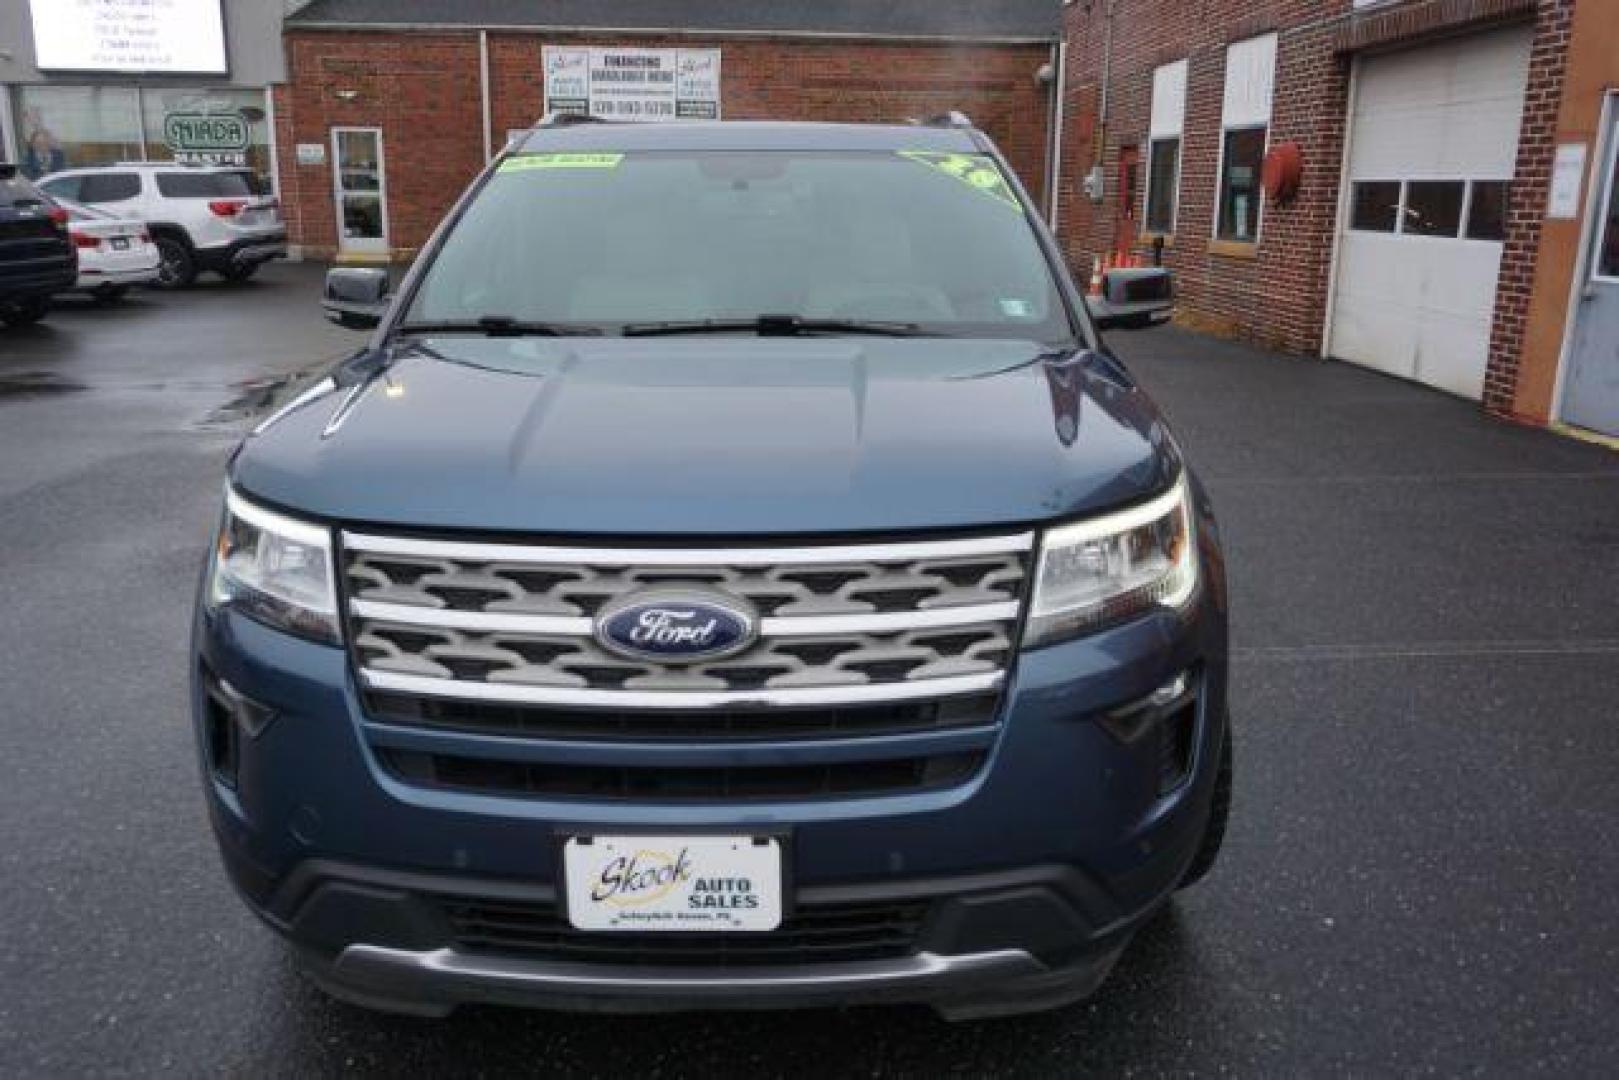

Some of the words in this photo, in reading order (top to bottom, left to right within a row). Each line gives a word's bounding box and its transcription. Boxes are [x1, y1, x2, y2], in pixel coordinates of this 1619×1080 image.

[629, 609, 717, 643] Ford
[591, 847, 691, 901] Skook
[695, 877, 751, 893] AUTO
[688, 894, 760, 909] SALES
